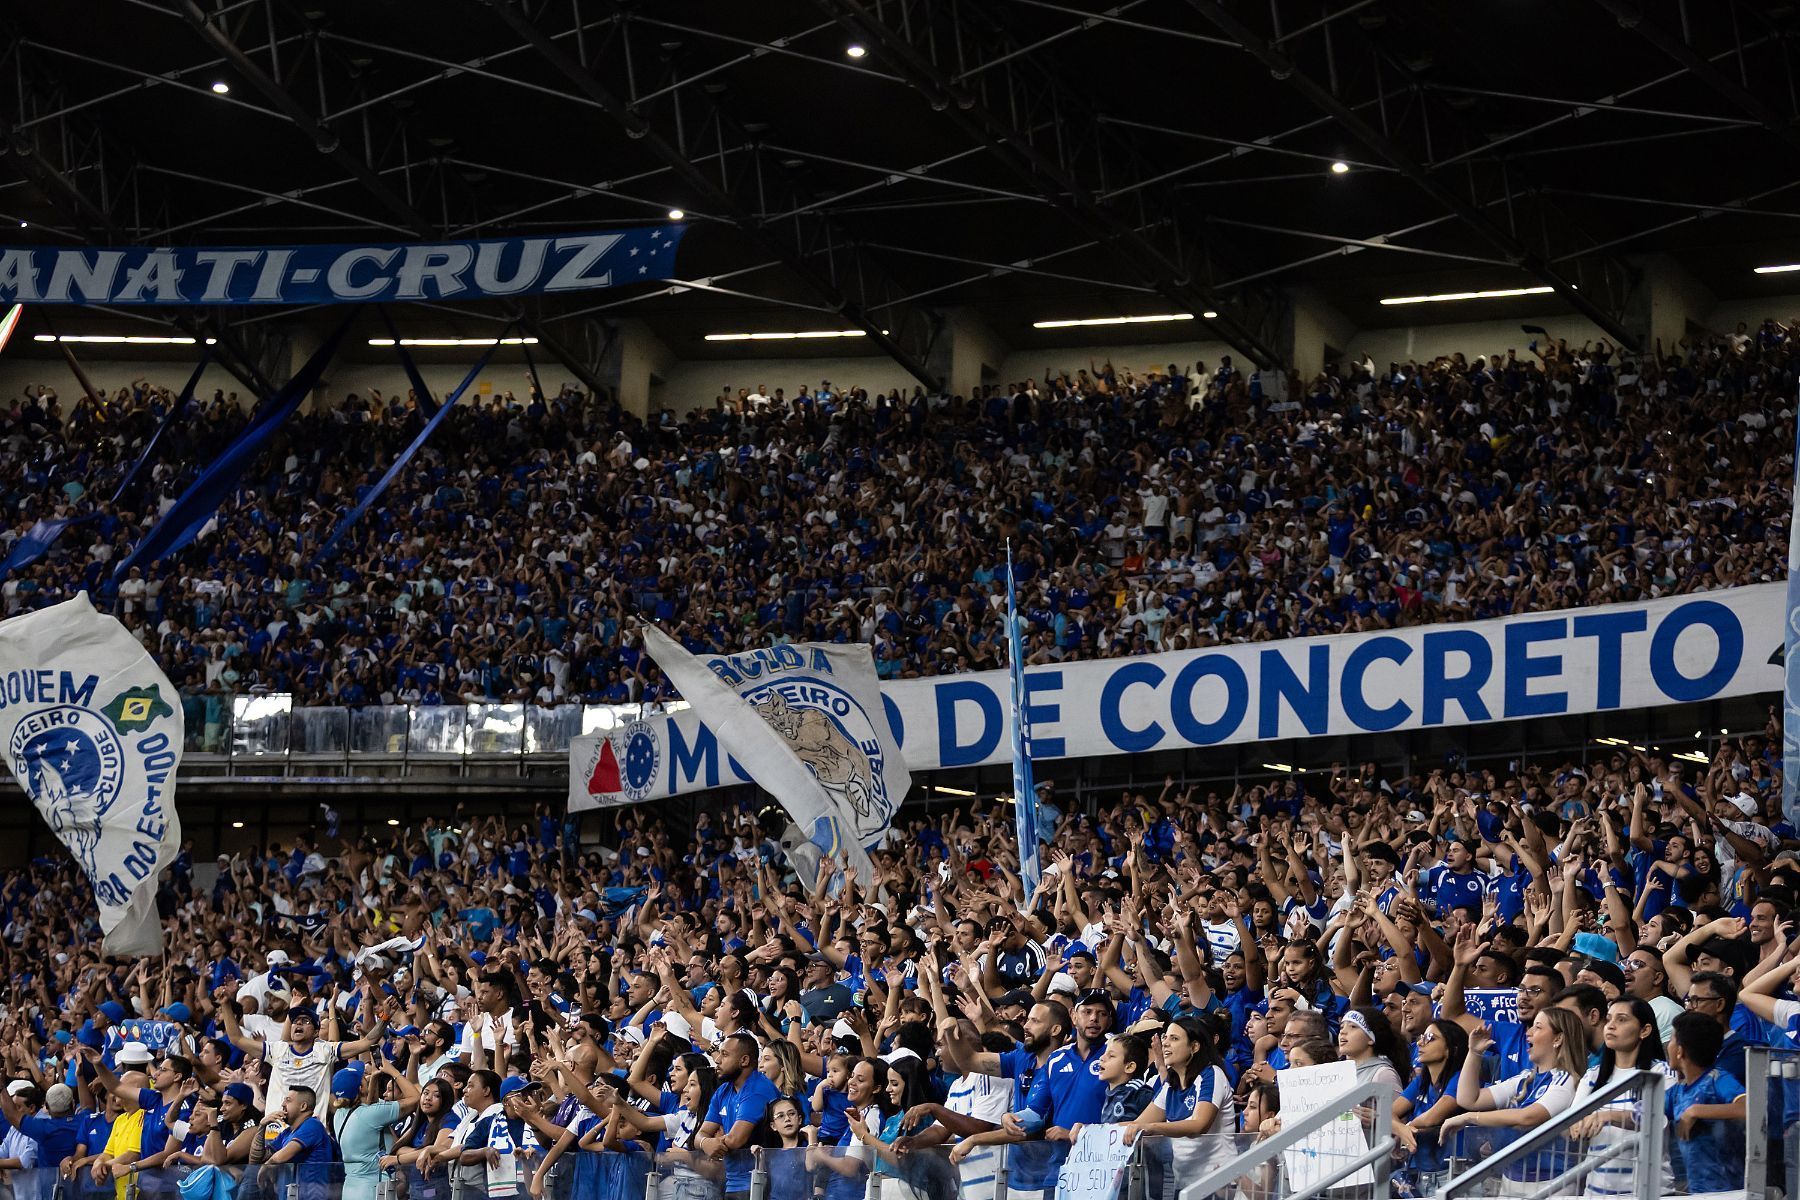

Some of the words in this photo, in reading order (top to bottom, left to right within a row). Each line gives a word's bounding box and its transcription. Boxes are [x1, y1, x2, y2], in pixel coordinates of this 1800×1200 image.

[935, 671, 1066, 767] DE
[1100, 600, 1744, 752] CONCRETO
[94, 729, 119, 794] CLUBE
[624, 723, 656, 749] CRUZEIRO
